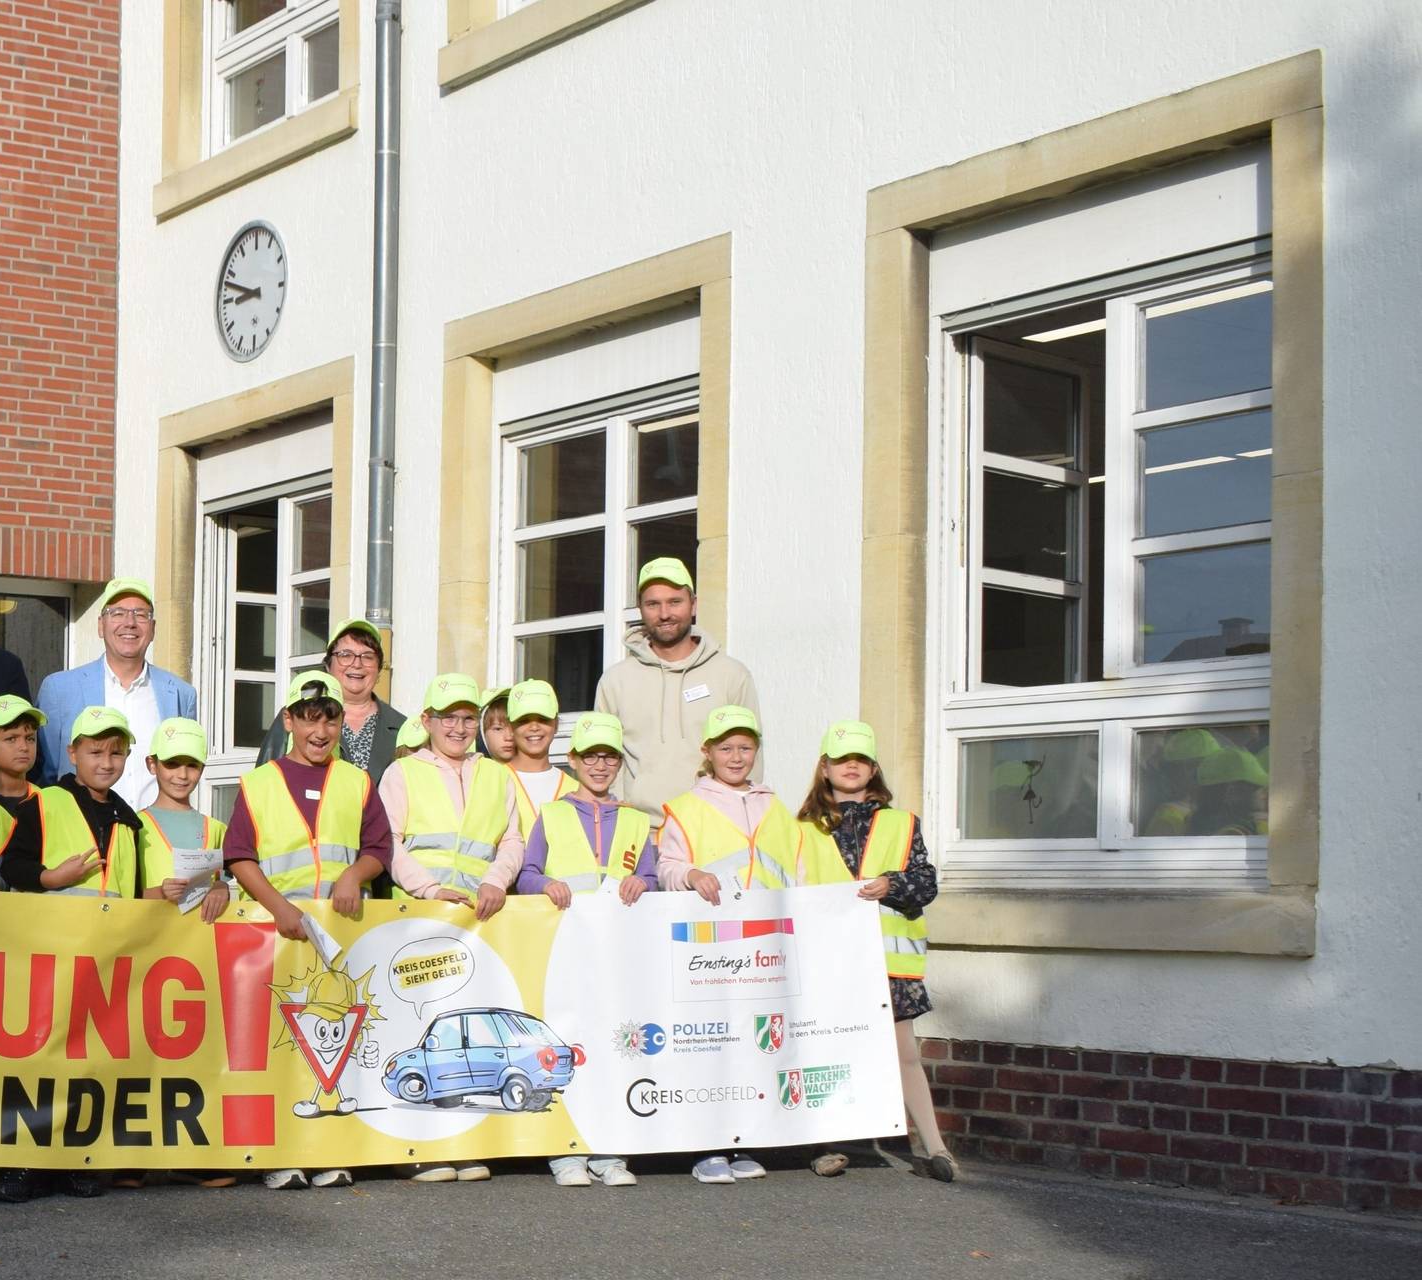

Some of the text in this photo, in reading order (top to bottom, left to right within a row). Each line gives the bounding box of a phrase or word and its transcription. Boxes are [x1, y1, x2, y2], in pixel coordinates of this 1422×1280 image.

[393, 952, 467, 976] KREIS COESFELD
[688, 955, 751, 974] Ernsting's
[405, 965, 461, 985] SIEHT GELB!
[673, 1022, 729, 1035] POLIZEI
